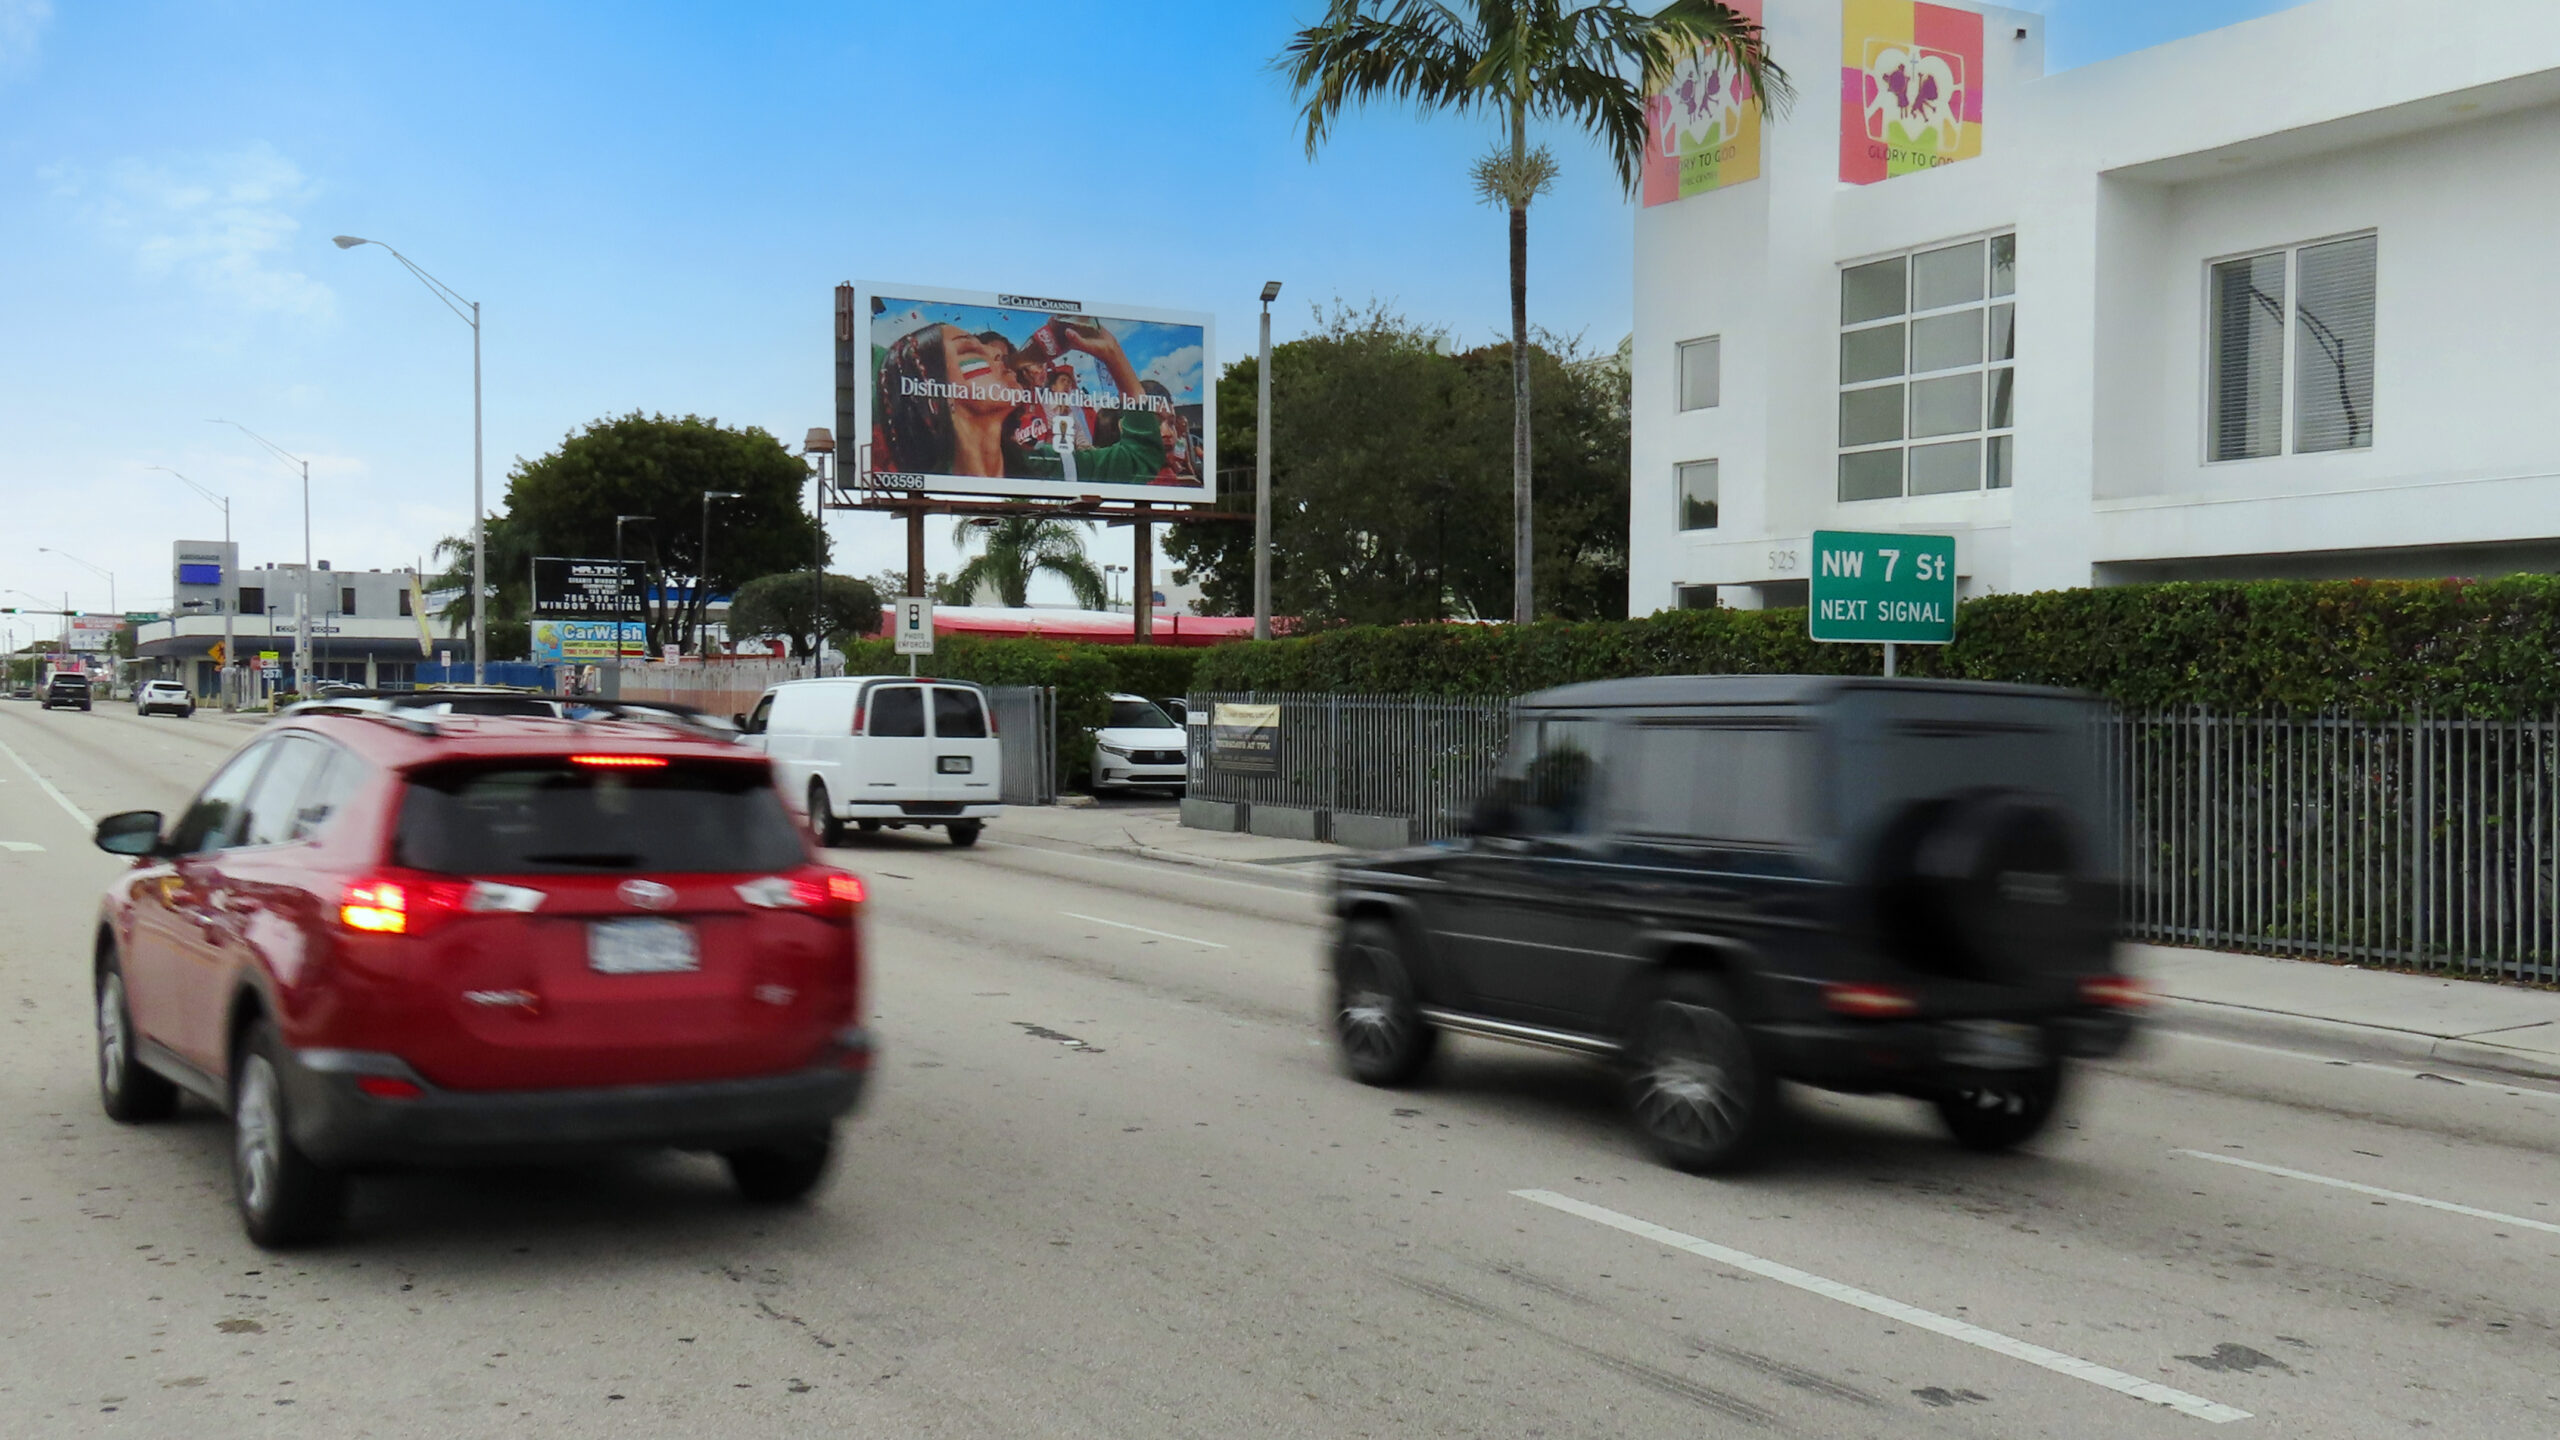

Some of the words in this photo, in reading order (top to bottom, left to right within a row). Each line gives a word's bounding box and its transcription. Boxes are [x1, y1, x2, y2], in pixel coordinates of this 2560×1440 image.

[1699, 152, 1712, 168] TO
[1868, 145, 1907, 163] GLORY
[1911, 152, 1926, 166] TO
[901, 375, 968, 400] Disfruta
[971, 381, 986, 401] la
[988, 383, 1032, 407] Copa
[1034, 386, 1096, 409] Mundial
[1100, 390, 1120, 410] de
[1122, 392, 1137, 411] la
[1139, 393, 1171, 414] FIFA
[1768, 550, 1798, 570] 525
[1822, 549, 1864, 578] NW
[1878, 548, 1900, 582] 7
[1916, 553, 1946, 582] St
[540, 601, 588, 610] WINDOW
[1820, 600, 1868, 621] NEXT
[1878, 600, 1946, 623] SIGNAL
[563, 624, 643, 641] CarWash
